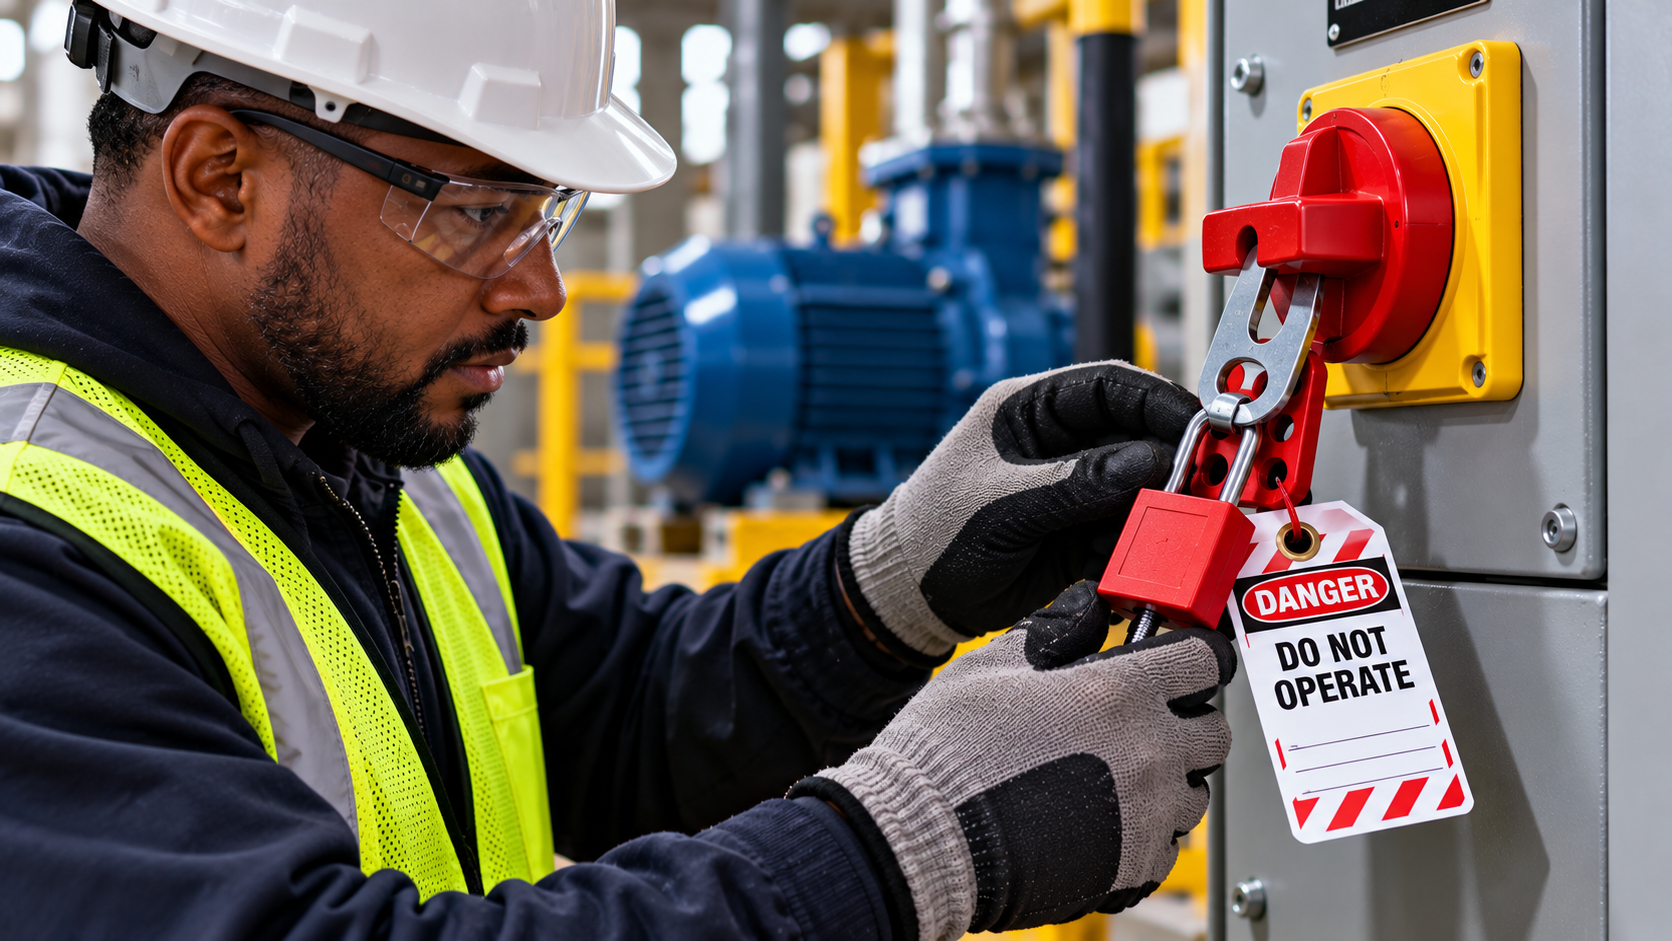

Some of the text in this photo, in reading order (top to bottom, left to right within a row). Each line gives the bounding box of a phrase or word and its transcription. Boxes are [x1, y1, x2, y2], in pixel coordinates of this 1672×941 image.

[1254, 573, 1380, 616] DANGER
[1275, 626, 1388, 671] DO NOT
[1274, 660, 1415, 710] OPERATE
